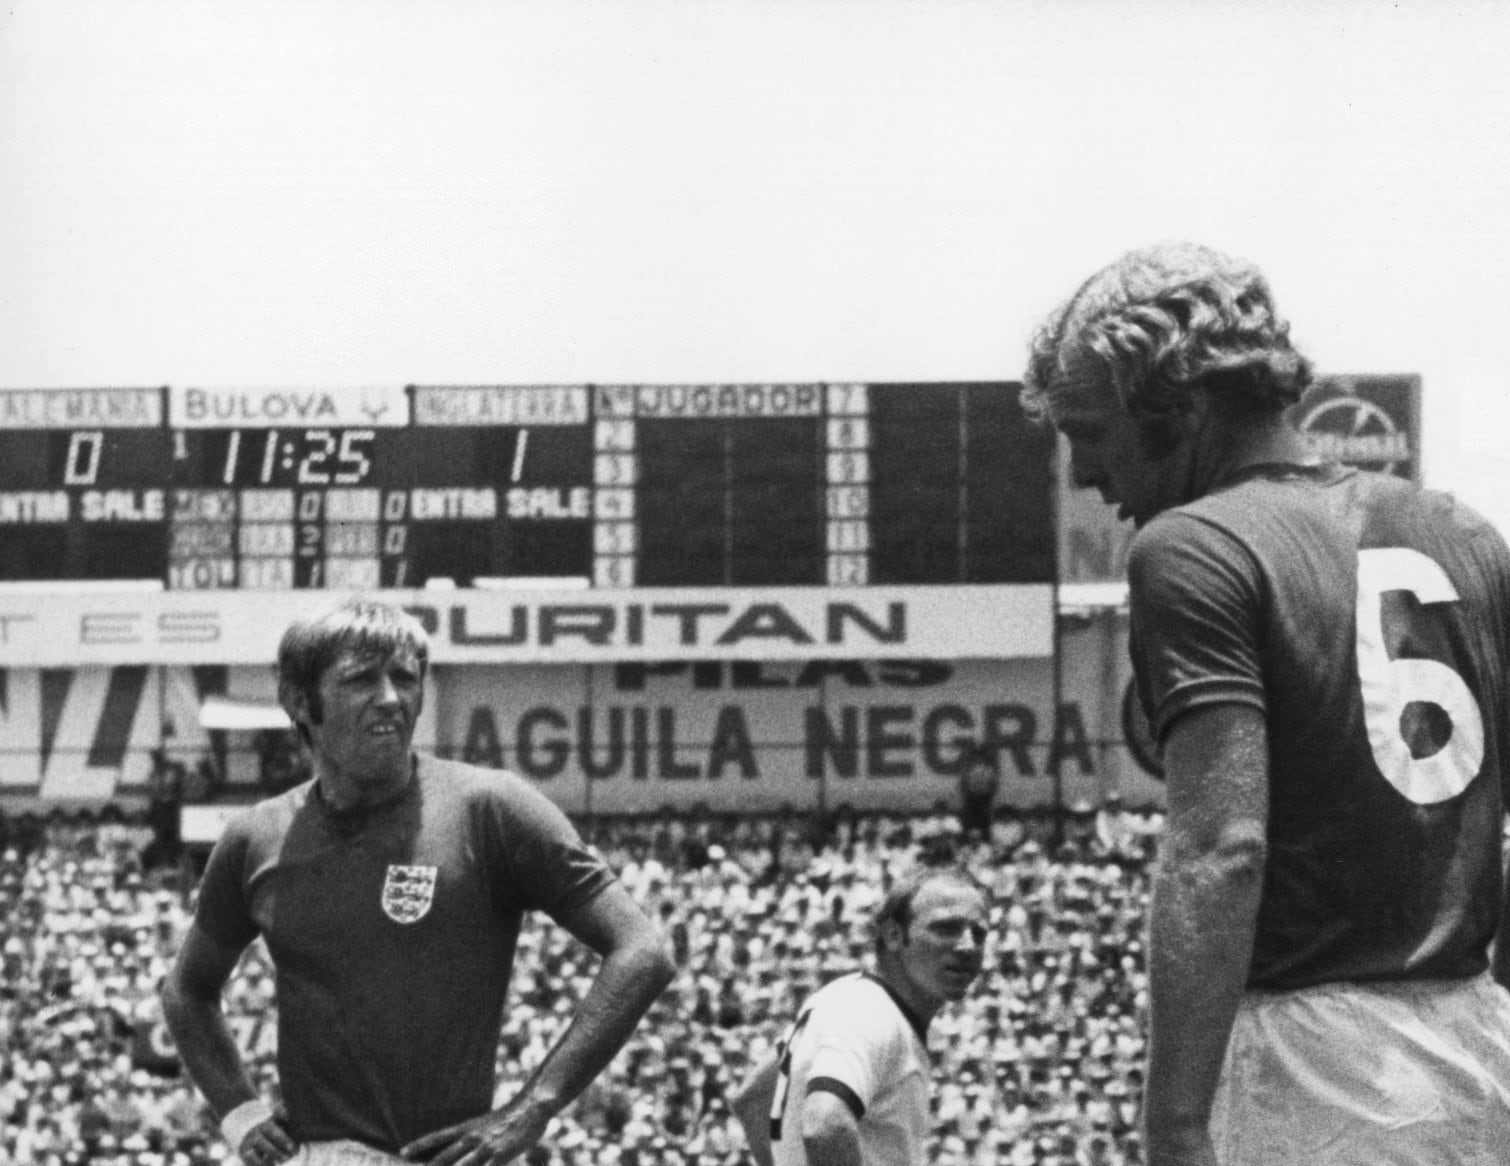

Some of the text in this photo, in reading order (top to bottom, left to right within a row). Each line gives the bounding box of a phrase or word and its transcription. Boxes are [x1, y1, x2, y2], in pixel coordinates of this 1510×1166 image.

[185, 389, 337, 420] BULOVA
[636, 387, 818, 416] JUGADOR
[65, 432, 104, 485] 0
[223, 430, 376, 484] 11:25
[511, 429, 529, 482] 1
[0, 489, 164, 521] NTRA SALE
[507, 487, 589, 519] SALE
[1356, 547, 1485, 806] 6
[459, 705, 759, 780] AGUILA
[804, 703, 1096, 778] NEGRA
